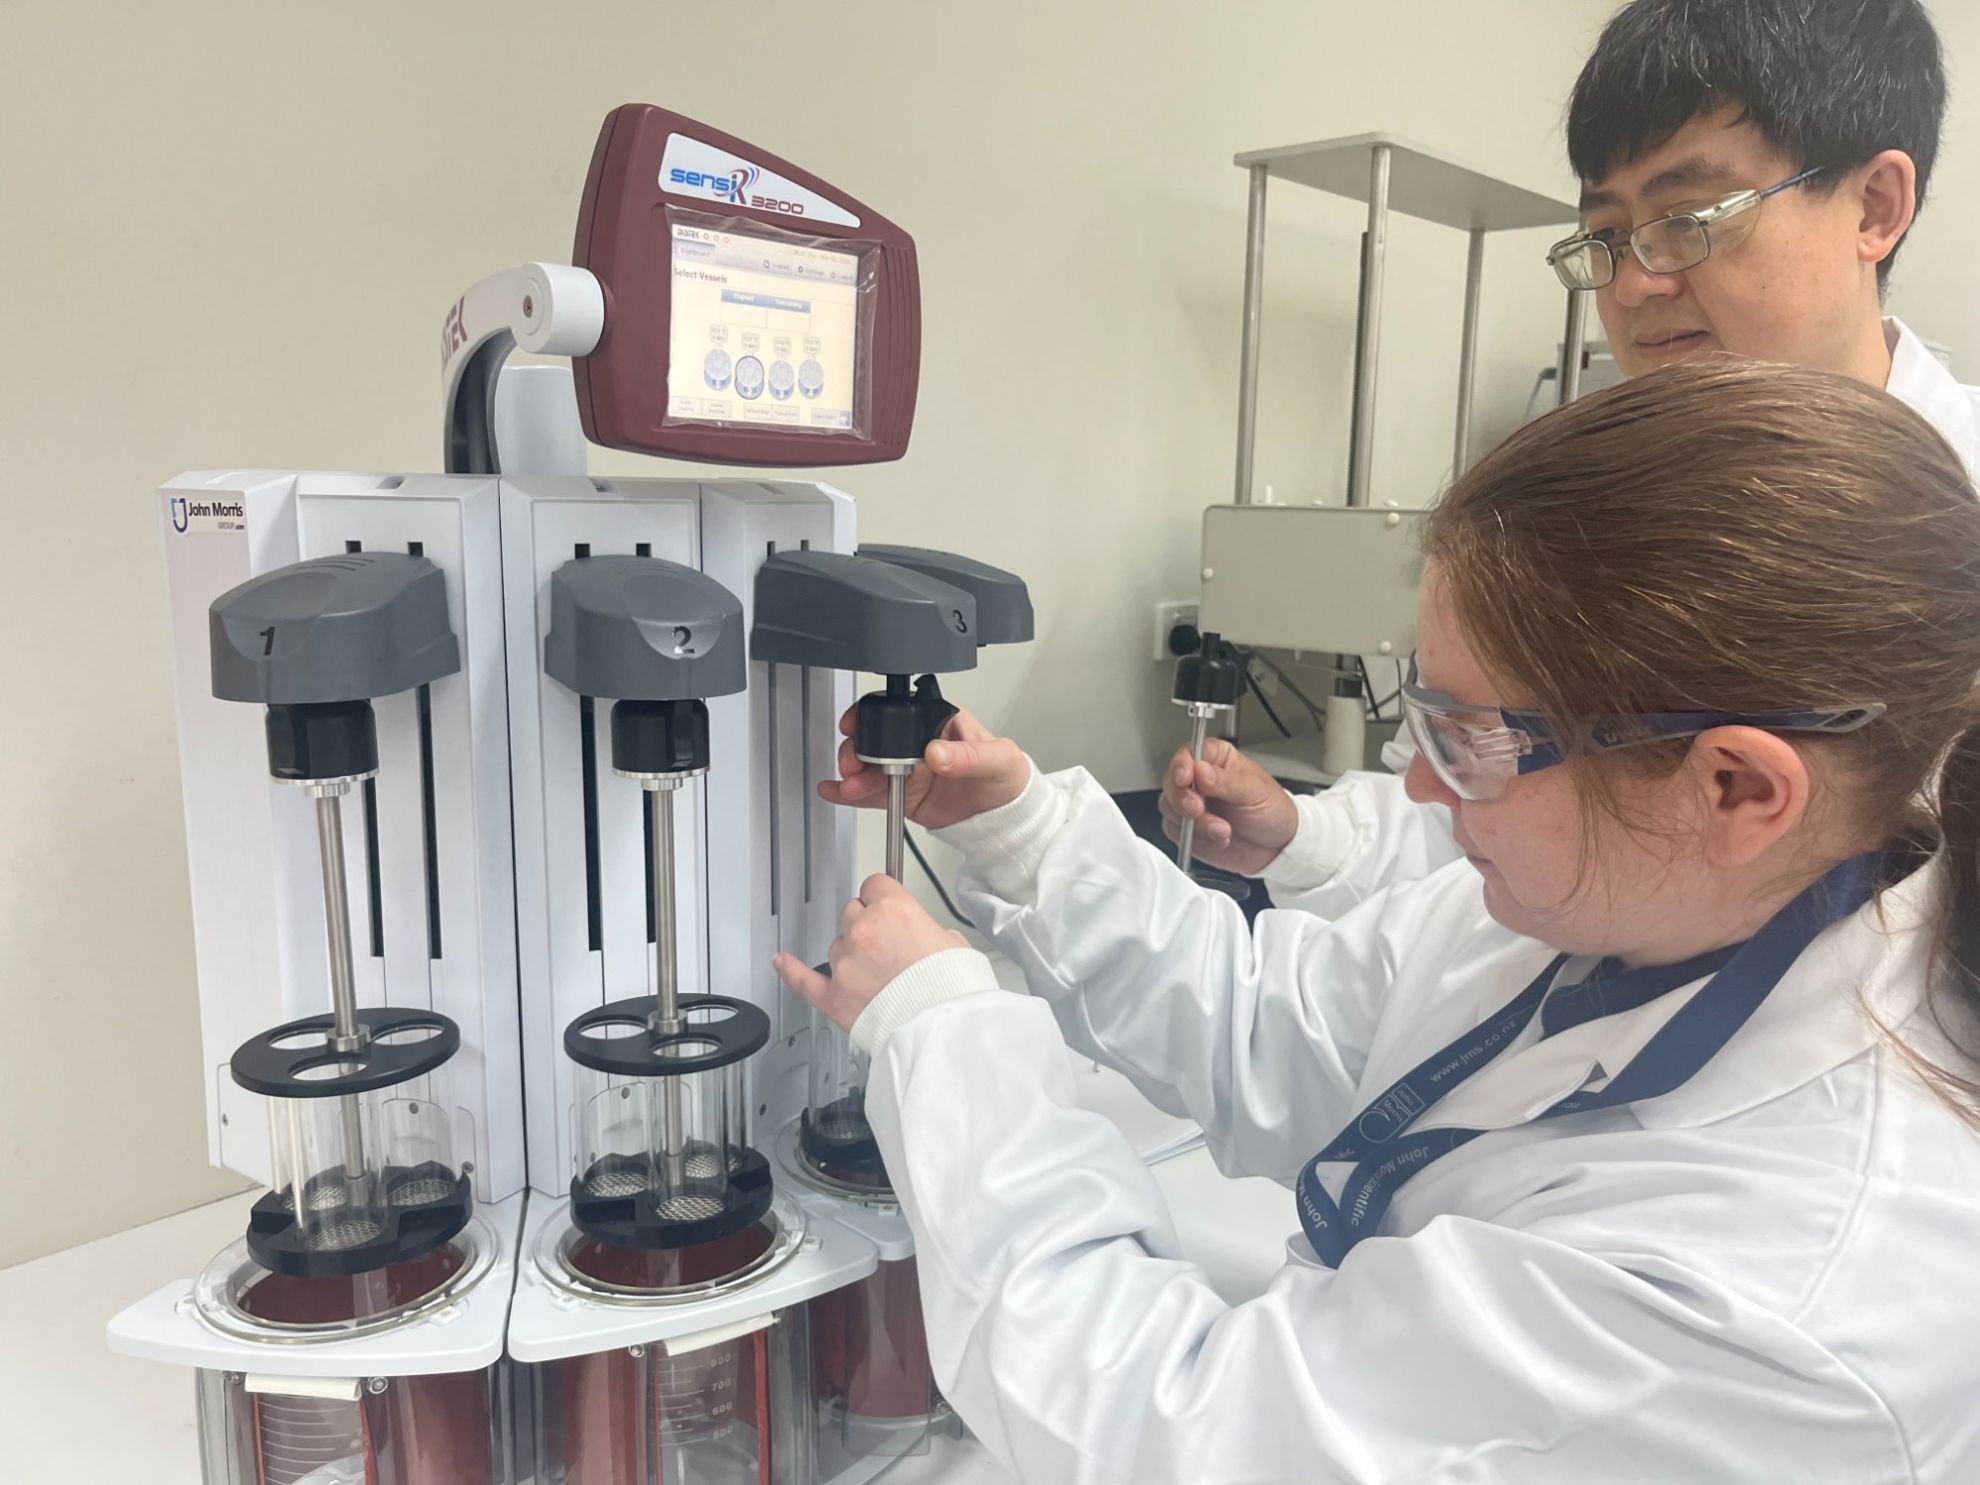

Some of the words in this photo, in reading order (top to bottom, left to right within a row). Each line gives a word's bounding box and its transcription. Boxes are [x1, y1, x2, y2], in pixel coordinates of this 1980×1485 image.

[752, 195, 804, 215] 3200
[699, 271, 728, 284] Vessels
[188, 502, 210, 517] John
[212, 502, 243, 517] Morris
[952, 609, 968, 634] 3
[259, 626, 275, 656] 1
[673, 625, 695, 654] 2
[1429, 1019, 1517, 1082] www.jms.co.nz
[1397, 1146, 1430, 1164] John
[1303, 1195, 1328, 1229] John
[711, 1378, 732, 1392] 700
[711, 1401, 733, 1416] 600
